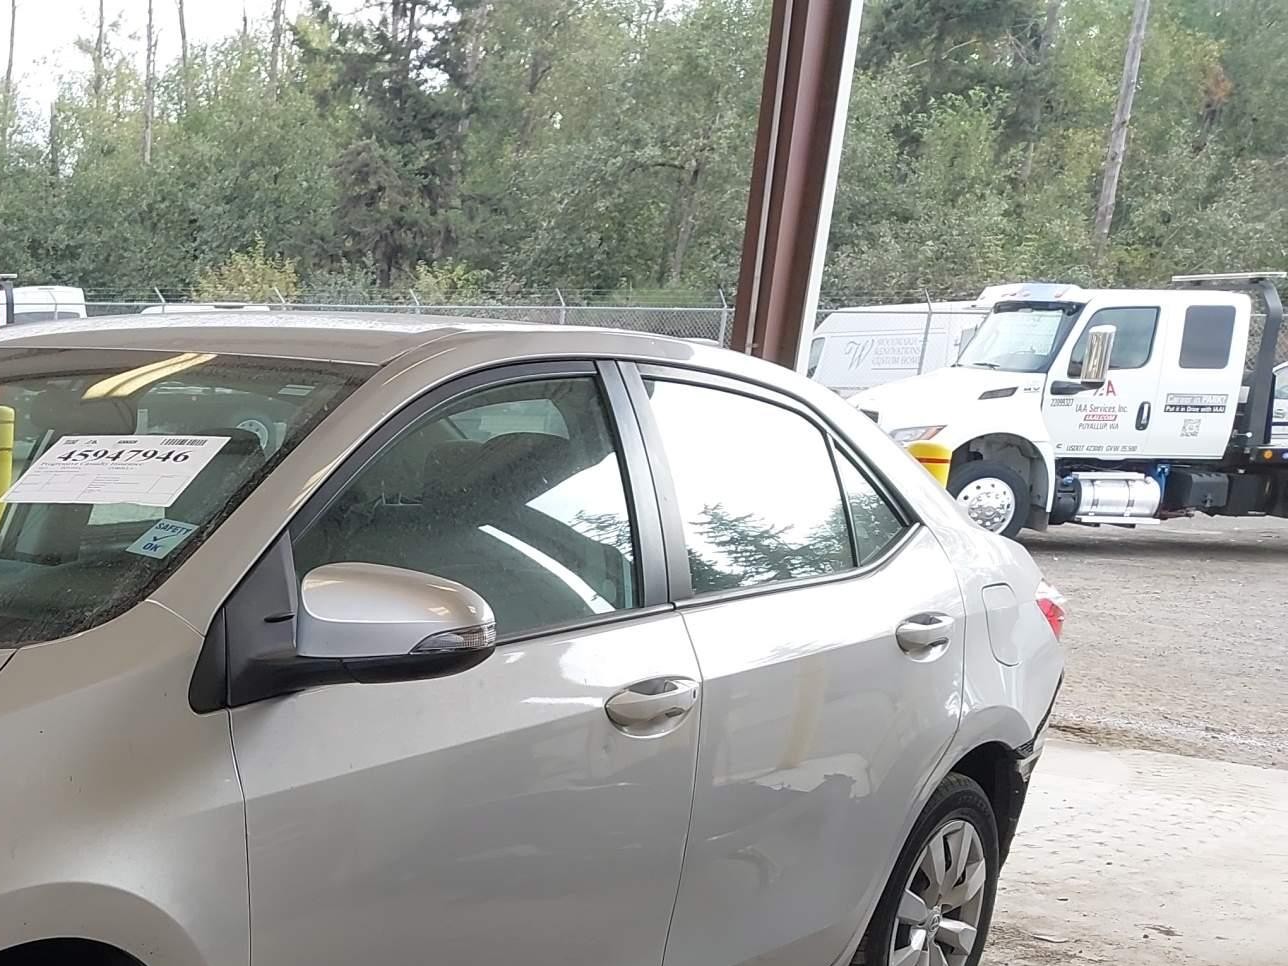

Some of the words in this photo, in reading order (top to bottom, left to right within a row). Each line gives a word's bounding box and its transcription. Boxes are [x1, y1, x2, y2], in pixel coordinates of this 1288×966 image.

[1076, 404, 1088, 412] IAA
[1118, 404, 1128, 412] Inc.
[57, 449, 192, 463] 45947946
[156, 523, 192, 535] SAFETY
[142, 543, 160, 552] OK
